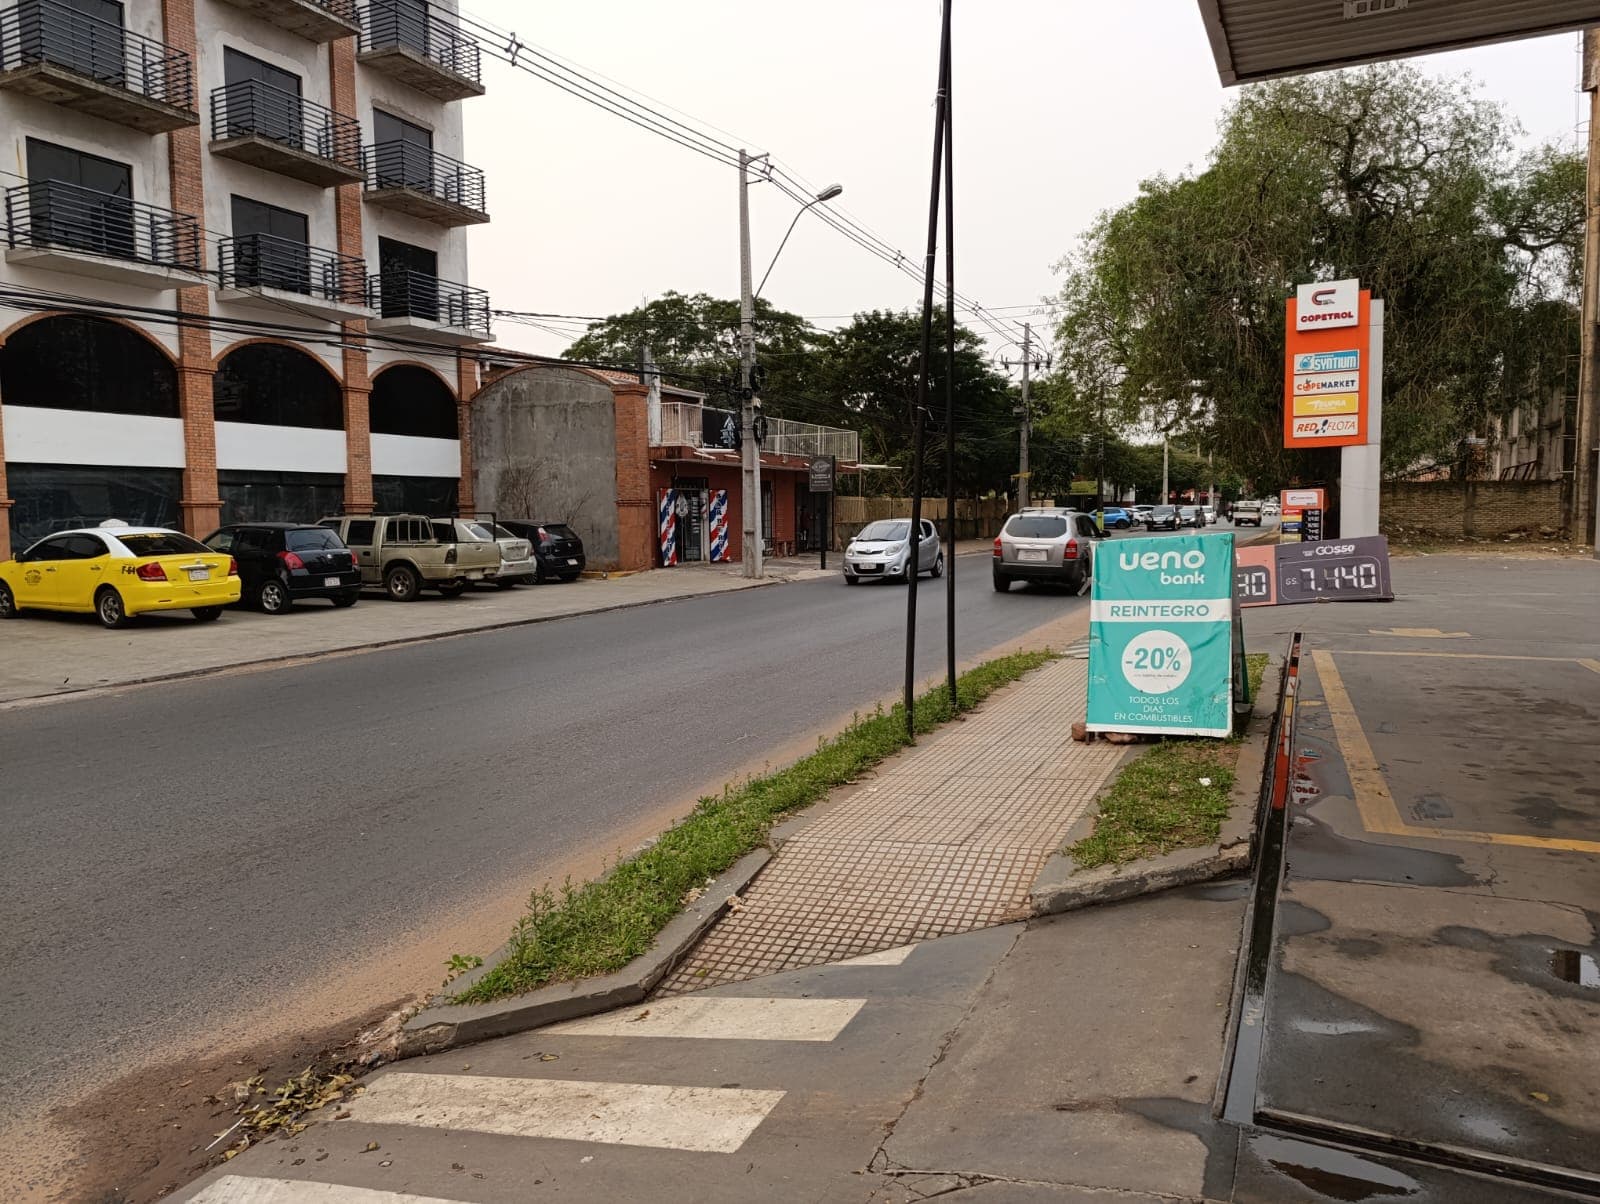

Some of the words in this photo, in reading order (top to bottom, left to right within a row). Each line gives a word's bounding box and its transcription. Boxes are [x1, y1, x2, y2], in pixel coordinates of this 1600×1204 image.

[1301, 311, 1354, 323] COPETROL
[1296, 379, 1356, 391] COPEMARKET
[1296, 423, 1318, 432] RED
[1326, 421, 1356, 431] FLOTA
[1119, 550, 1206, 571] ueno
[1160, 571, 1205, 585] bank
[1110, 604, 1209, 617] REINTEGRO
[1125, 647, 1181, 671] -20%
[1128, 696, 1160, 705] TODOS
[1162, 697, 1180, 705] LOS
[1114, 713, 1126, 721] EN
[1128, 713, 1193, 723] COMBUSTIBLES
